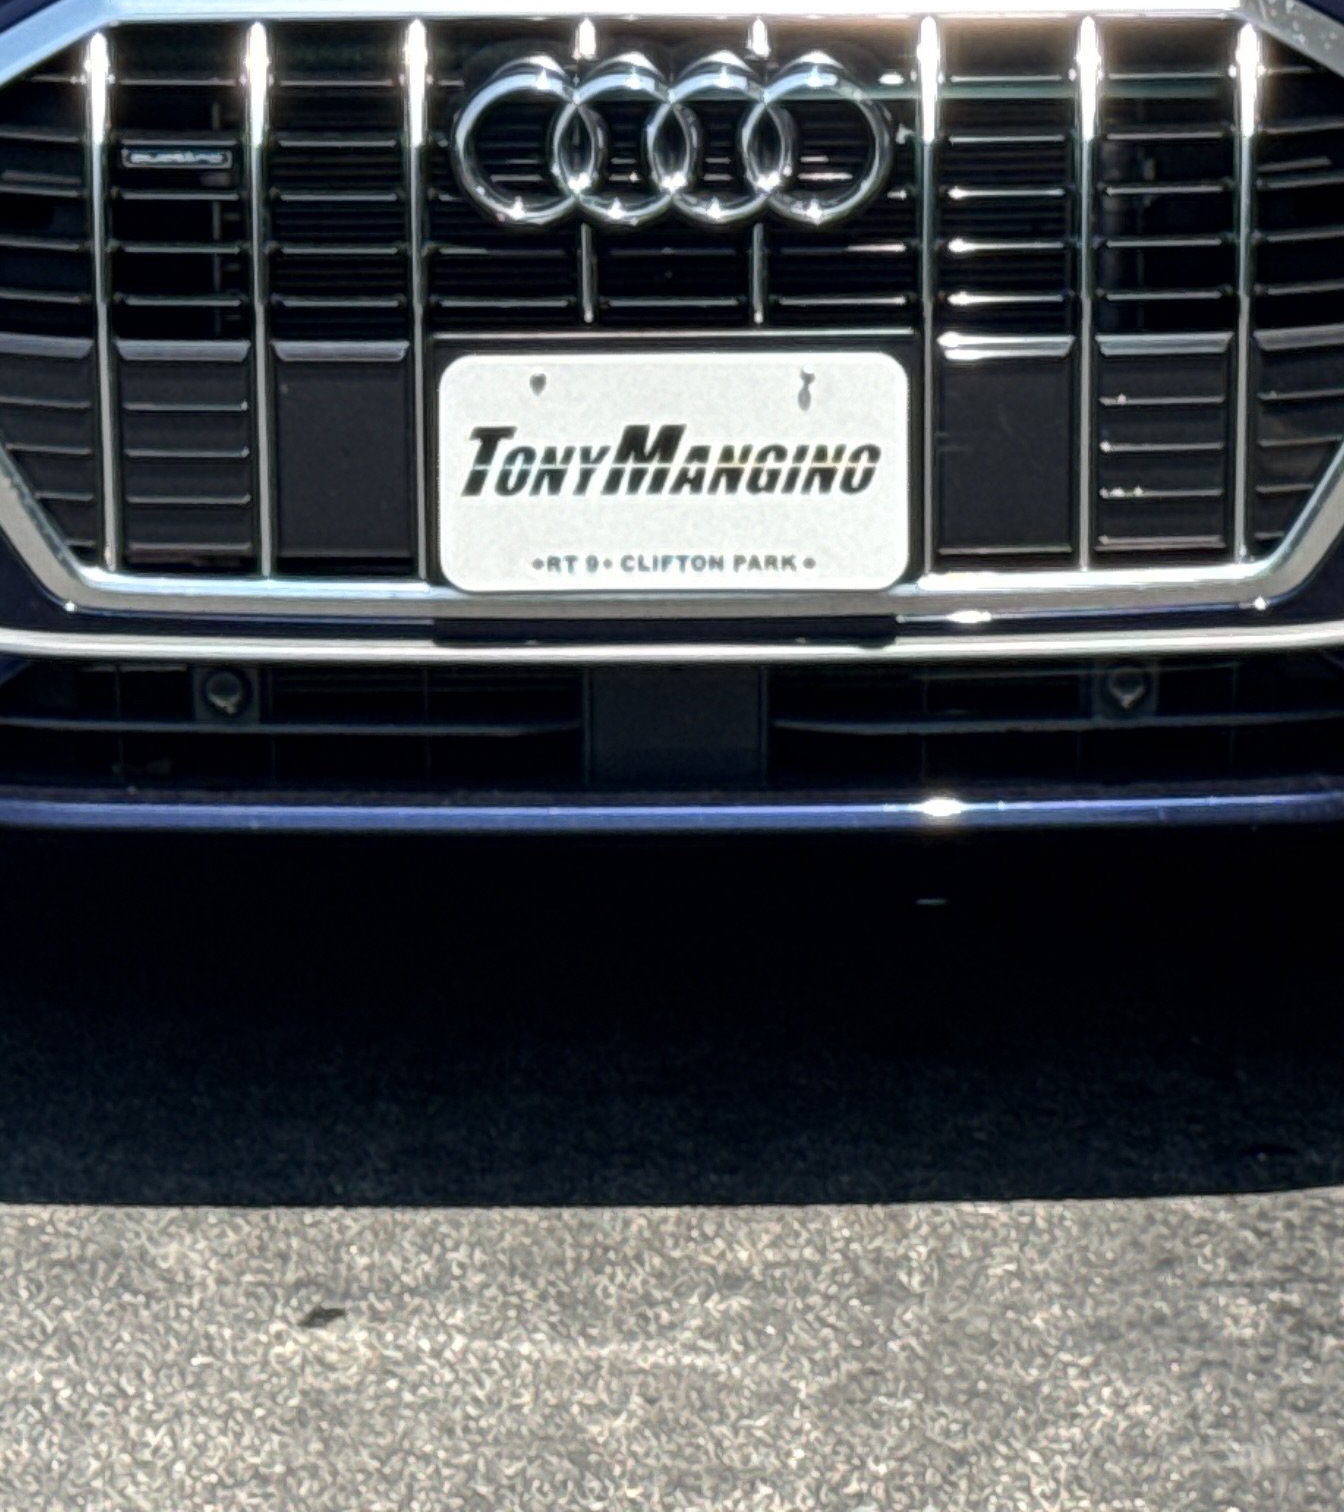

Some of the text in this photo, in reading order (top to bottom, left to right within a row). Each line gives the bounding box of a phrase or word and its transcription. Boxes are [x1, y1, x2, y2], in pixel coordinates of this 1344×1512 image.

[547, 555, 797, 573] RT 9 CLIFTON PARK
